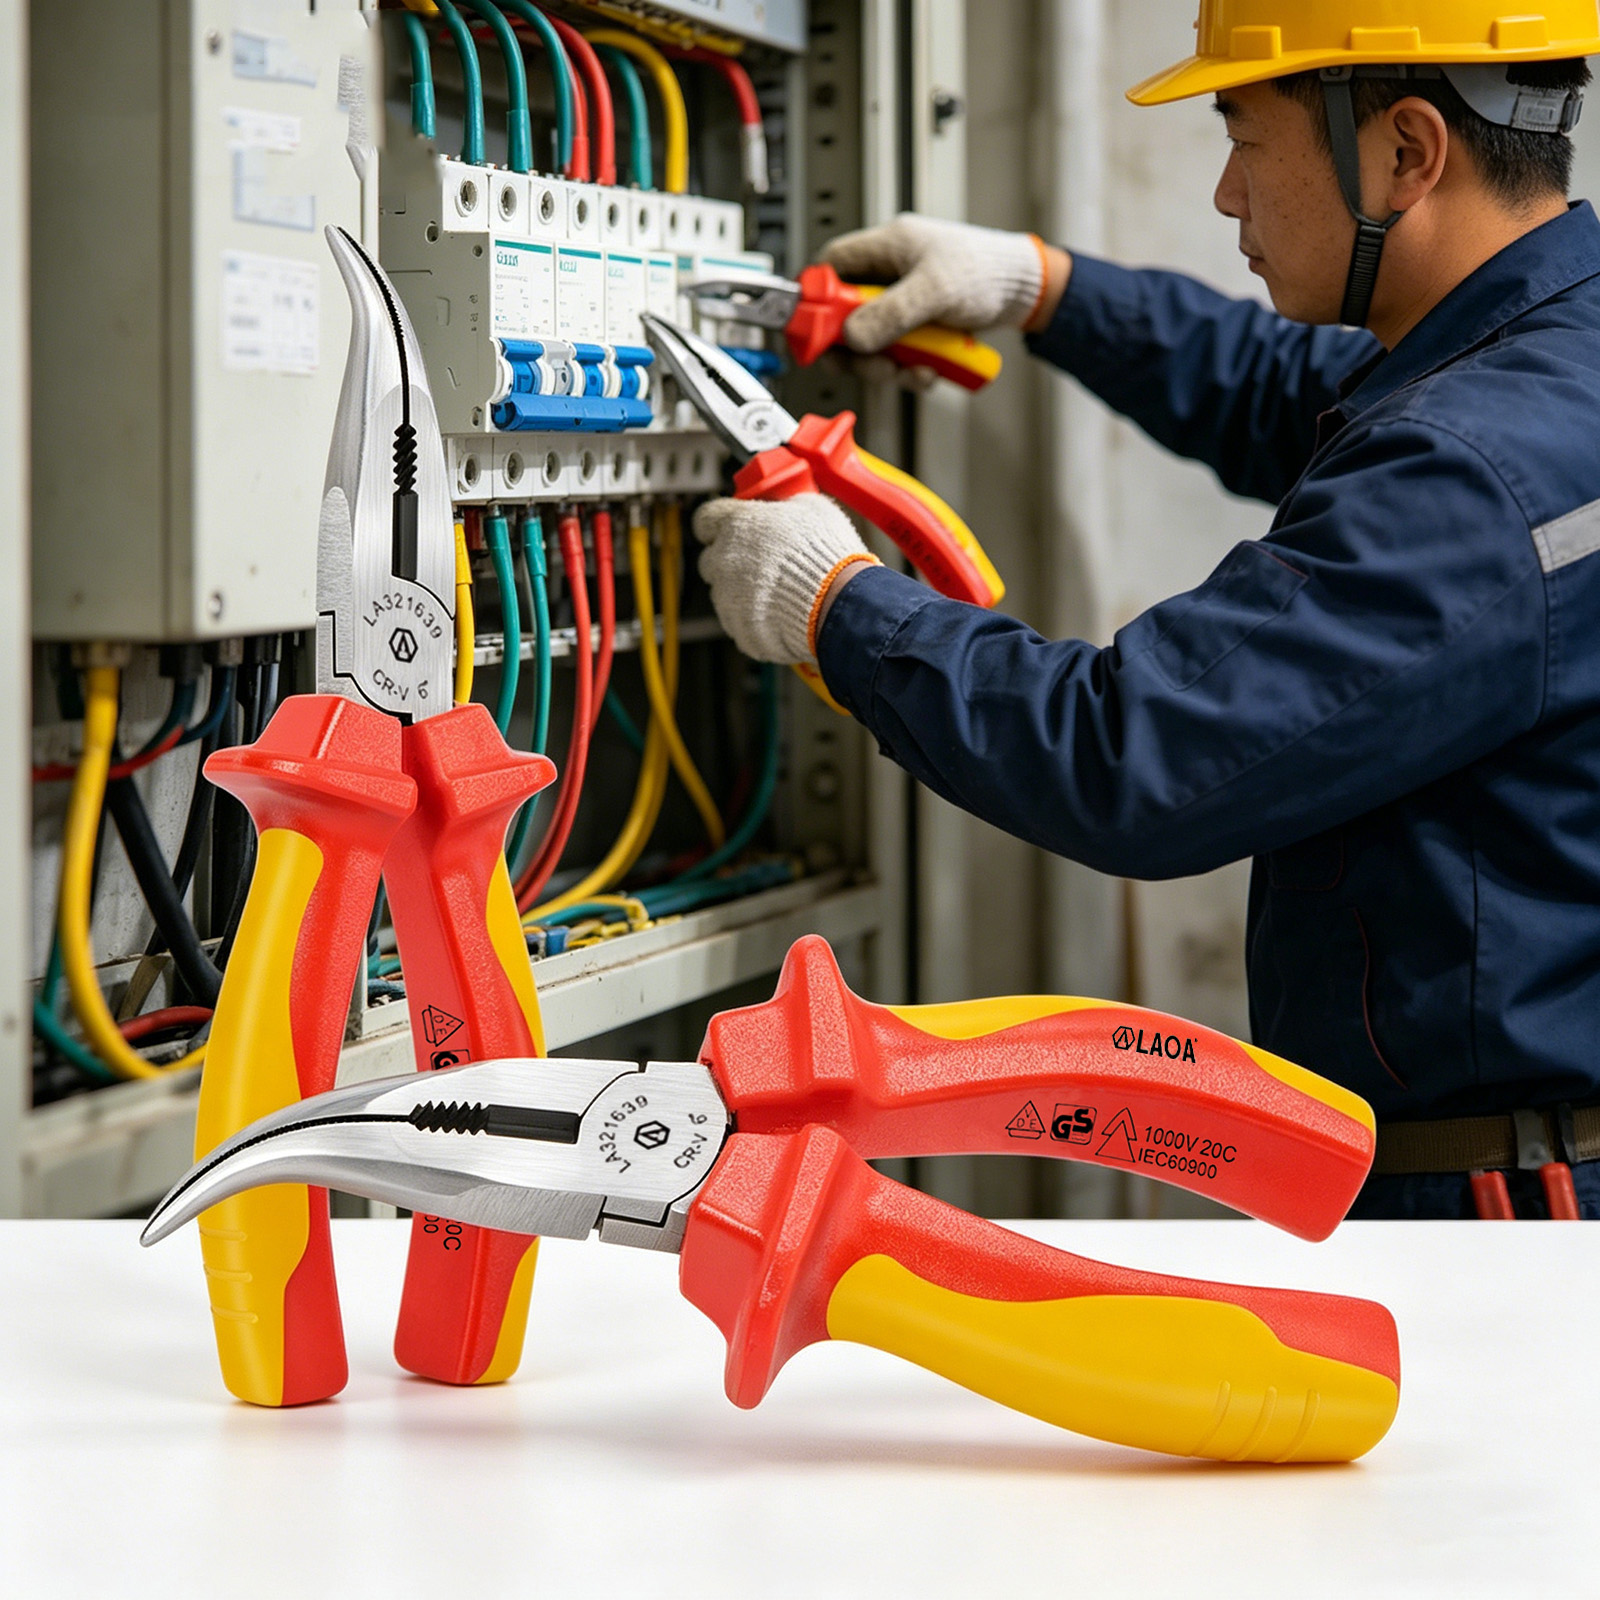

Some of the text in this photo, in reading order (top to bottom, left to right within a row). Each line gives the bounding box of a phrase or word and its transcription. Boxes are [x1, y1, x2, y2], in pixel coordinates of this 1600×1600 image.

[372, 669, 428, 700] CR-V 6
[1136, 1029, 1196, 1063] LAOA
[673, 1113, 708, 1168] CR-V 6
[1051, 1108, 1093, 1140] GS
[1145, 1126, 1237, 1163] 1000V 20C
[1138, 1148, 1217, 1179] IEC60900
